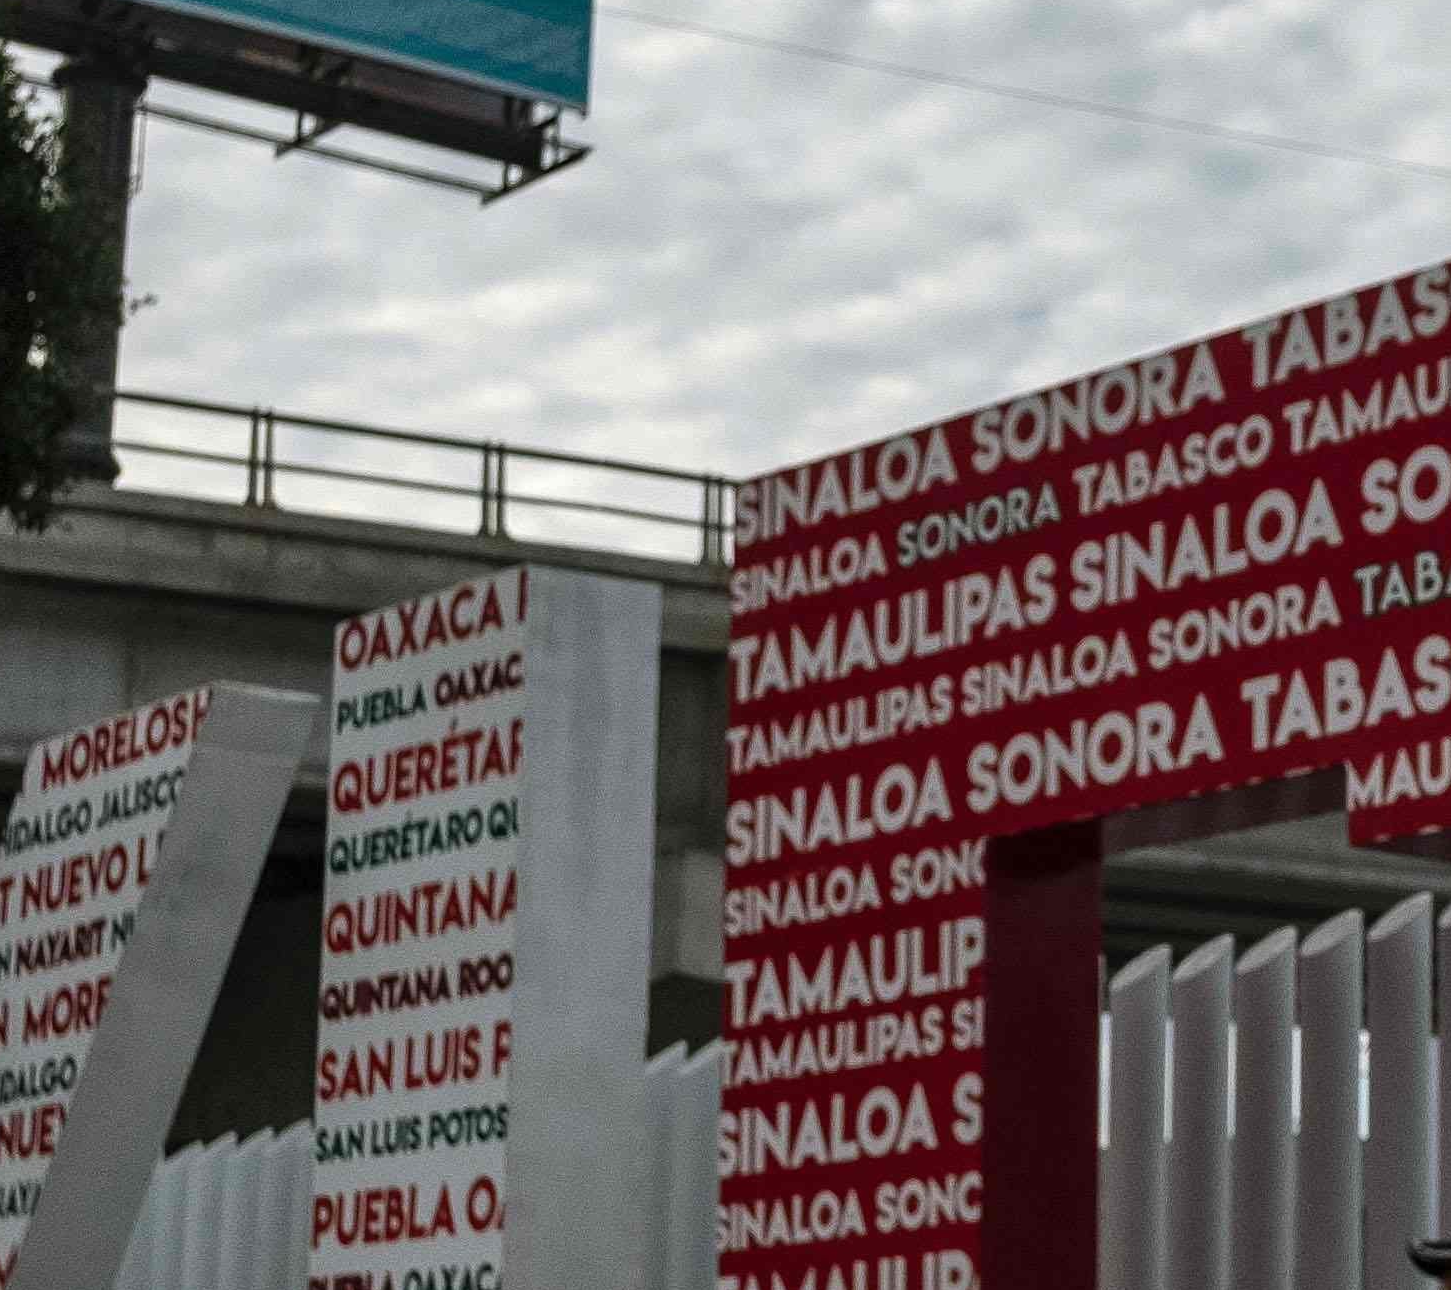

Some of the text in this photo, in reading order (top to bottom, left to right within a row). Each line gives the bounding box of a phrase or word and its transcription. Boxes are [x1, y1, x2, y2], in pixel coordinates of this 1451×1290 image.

[735, 425, 956, 545] SINALOA
[973, 342, 1224, 472] SONORA
[732, 536, 886, 614] SINALOA
[898, 484, 1060, 566] SONORA
[1074, 415, 1272, 514] TABASCO
[338, 584, 503, 670] OAXACA
[730, 555, 1055, 701] TAMAULIPAS
[1071, 480, 1342, 610] SINALOA
[337, 685, 426, 732] PUEBLA
[729, 676, 952, 771] TAMAULIPAS
[962, 633, 1136, 715] SINALOA
[1149, 580, 1340, 669] SONORA
[727, 759, 951, 865] SINALOA
[968, 695, 1223, 811] SONORA
[330, 809, 482, 875] QUERÉTARO
[725, 867, 880, 936] SINALOA
[320, 954, 513, 1020] QUINTANA ROO
[317, 1026, 481, 1101] SAN LUIS
[723, 1007, 943, 1087] TAMAULIPAS
[316, 1126, 364, 1163] SAN
[371, 1116, 421, 1157] LUIS
[722, 1085, 937, 1178] SINALOA
[312, 1187, 455, 1248] PUEBLA
